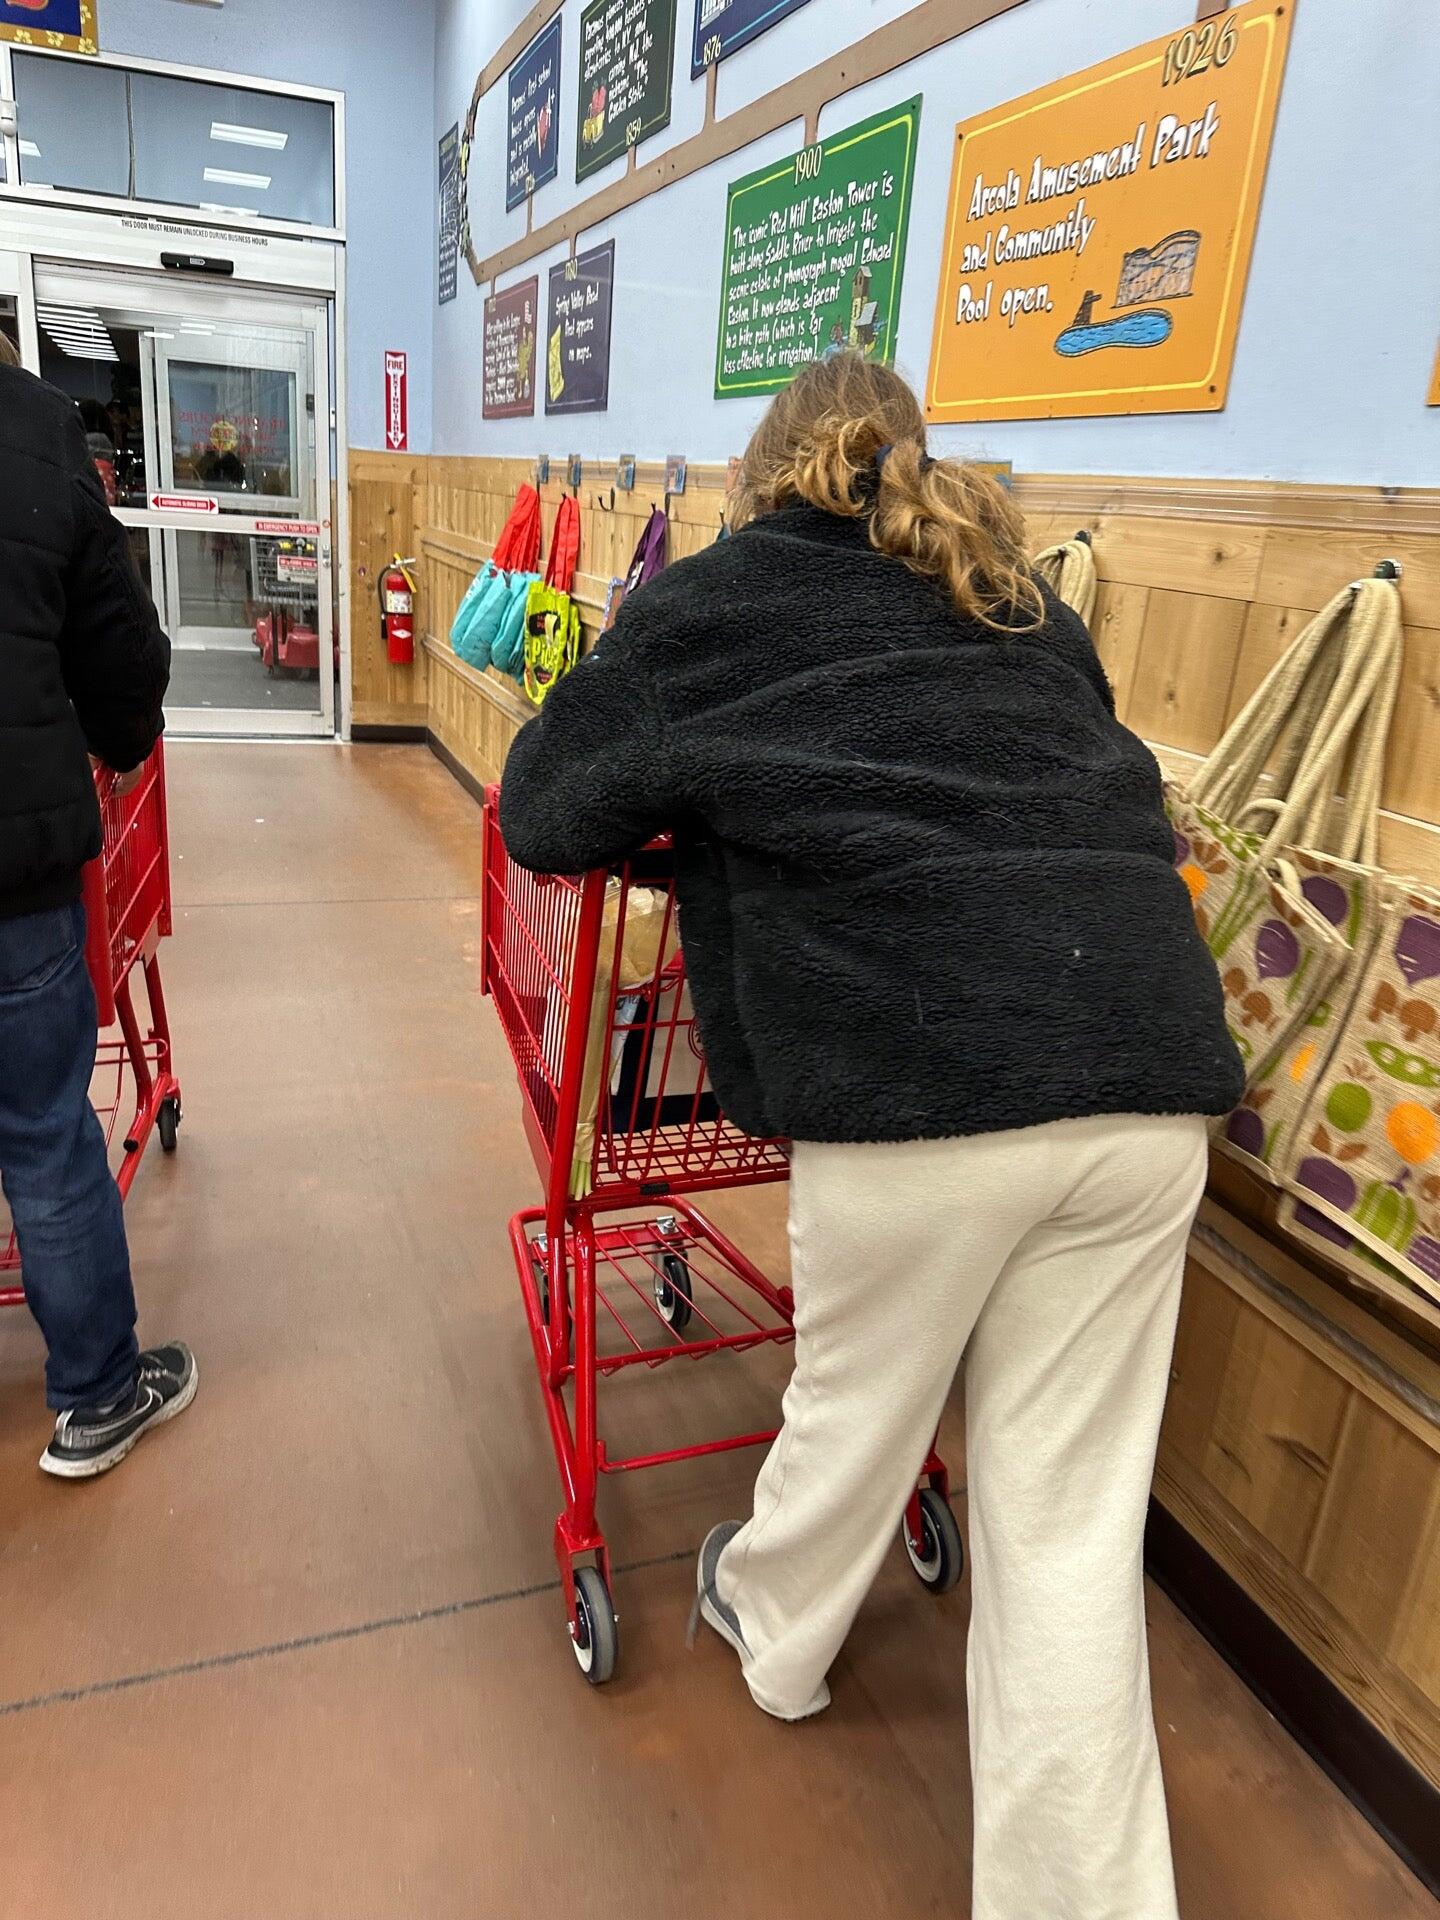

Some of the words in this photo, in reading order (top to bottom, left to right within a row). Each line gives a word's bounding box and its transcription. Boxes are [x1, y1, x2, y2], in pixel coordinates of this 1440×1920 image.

[635, 9, 647, 38] and
[642, 30, 653, 53] the
[703, 34, 722, 66] 1876
[1162, 12, 1238, 87] 1926
[626, 117, 641, 146] 1859
[795, 145, 822, 185] 1900
[967, 169, 1021, 222] Arcola
[1025, 122, 1147, 204] Amusement
[1150, 100, 1221, 169] Park
[733, 226, 746, 249] The
[749, 219, 768, 244] iconic
[812, 189, 843, 223] Easton
[848, 181, 878, 208] Tower
[882, 170, 893, 196] is
[121, 220, 133, 228] THIS
[133, 221, 148, 230] DOOR
[148, 222, 162, 232] MUST
[163, 224, 183, 234] REMAIN
[183, 228, 208, 238] UNLOCKED
[209, 231, 228, 241] DURING
[228, 234, 251, 244] BUSINESS
[251, 236, 268, 246] HOURS
[730, 251, 746, 276] built
[747, 246, 764, 271] along
[765, 236, 790, 265] Saddle
[792, 231, 813, 255] River
[816, 224, 824, 247] to
[826, 216, 856, 246] Irrigate
[861, 207, 878, 233] the
[960, 231, 992, 273] and
[994, 197, 1096, 265] Community
[729, 278, 749, 301] scenic
[750, 268, 771, 295] estate
[773, 266, 783, 289] of
[783, 251, 826, 292] phonograph
[830, 240, 858, 276] mogul
[861, 232, 894, 264] Edward
[571, 290, 585, 313] Valley
[752, 297, 759, 320] It
[761, 301, 774, 318] now
[775, 288, 800, 316] stands
[803, 278, 840, 315] adjacent
[956, 280, 994, 325] Pool
[1000, 284, 1054, 328] open.
[725, 331, 732, 349] to
[732, 333, 737, 349] a
[754, 323, 770, 351] path
[772, 316, 795, 344] (which
[798, 316, 805, 336] is
[809, 312, 824, 336] far
[388, 360, 403, 369] FIRE
[724, 355, 736, 374] less
[737, 349, 764, 371] effective
[766, 345, 777, 368] for
